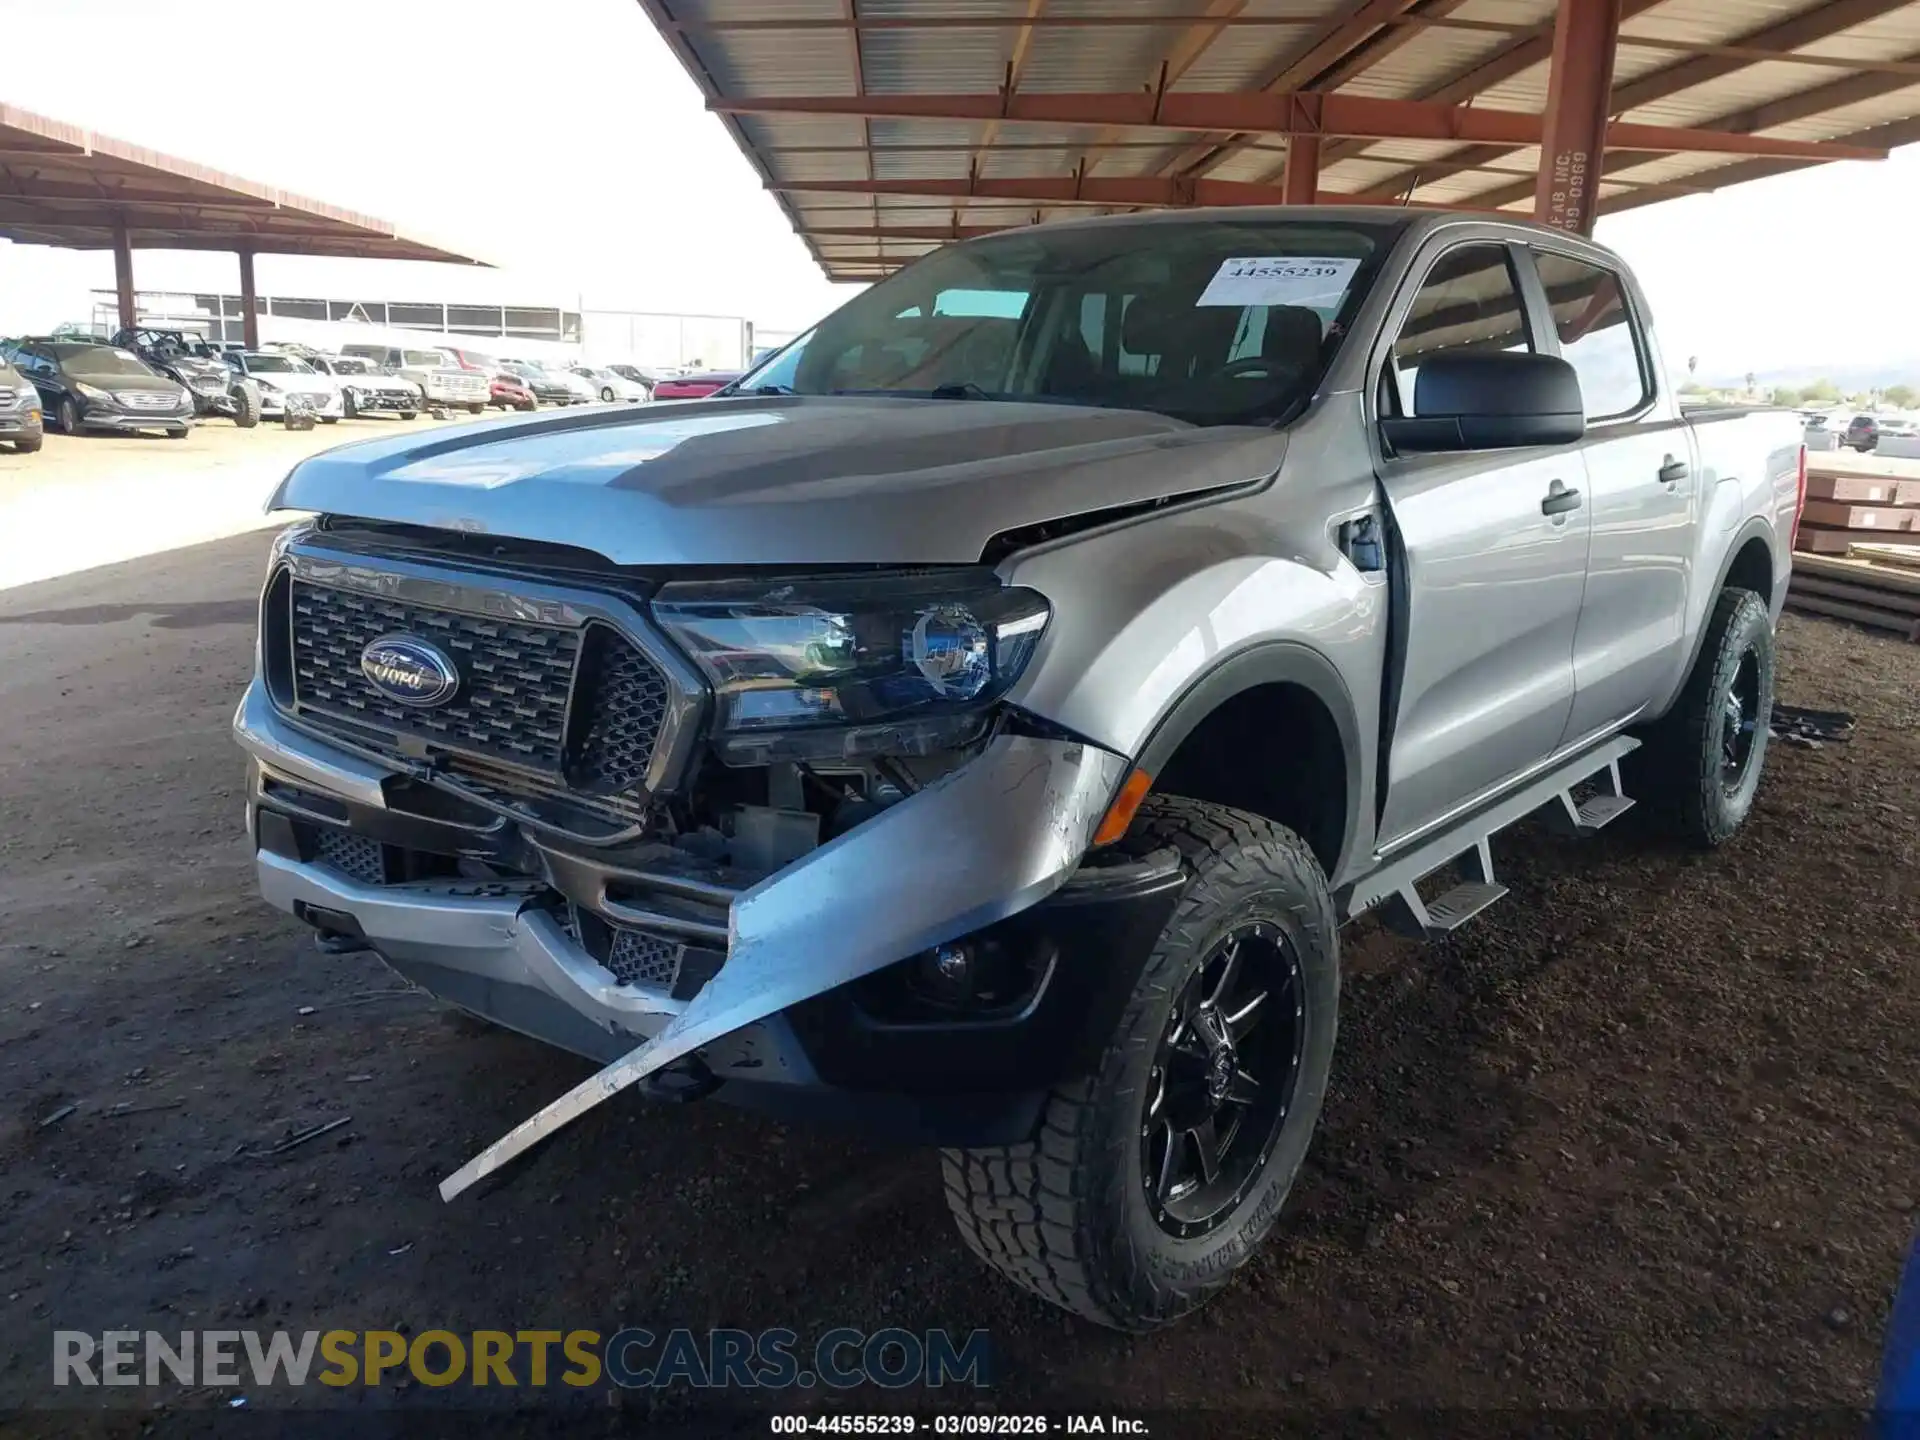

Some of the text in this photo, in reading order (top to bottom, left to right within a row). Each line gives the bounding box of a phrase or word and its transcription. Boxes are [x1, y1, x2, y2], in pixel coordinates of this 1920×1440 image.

[1554, 149, 1572, 182] INC.
[1230, 266, 1337, 277] 44555239
[374, 650, 424, 690] Ford
